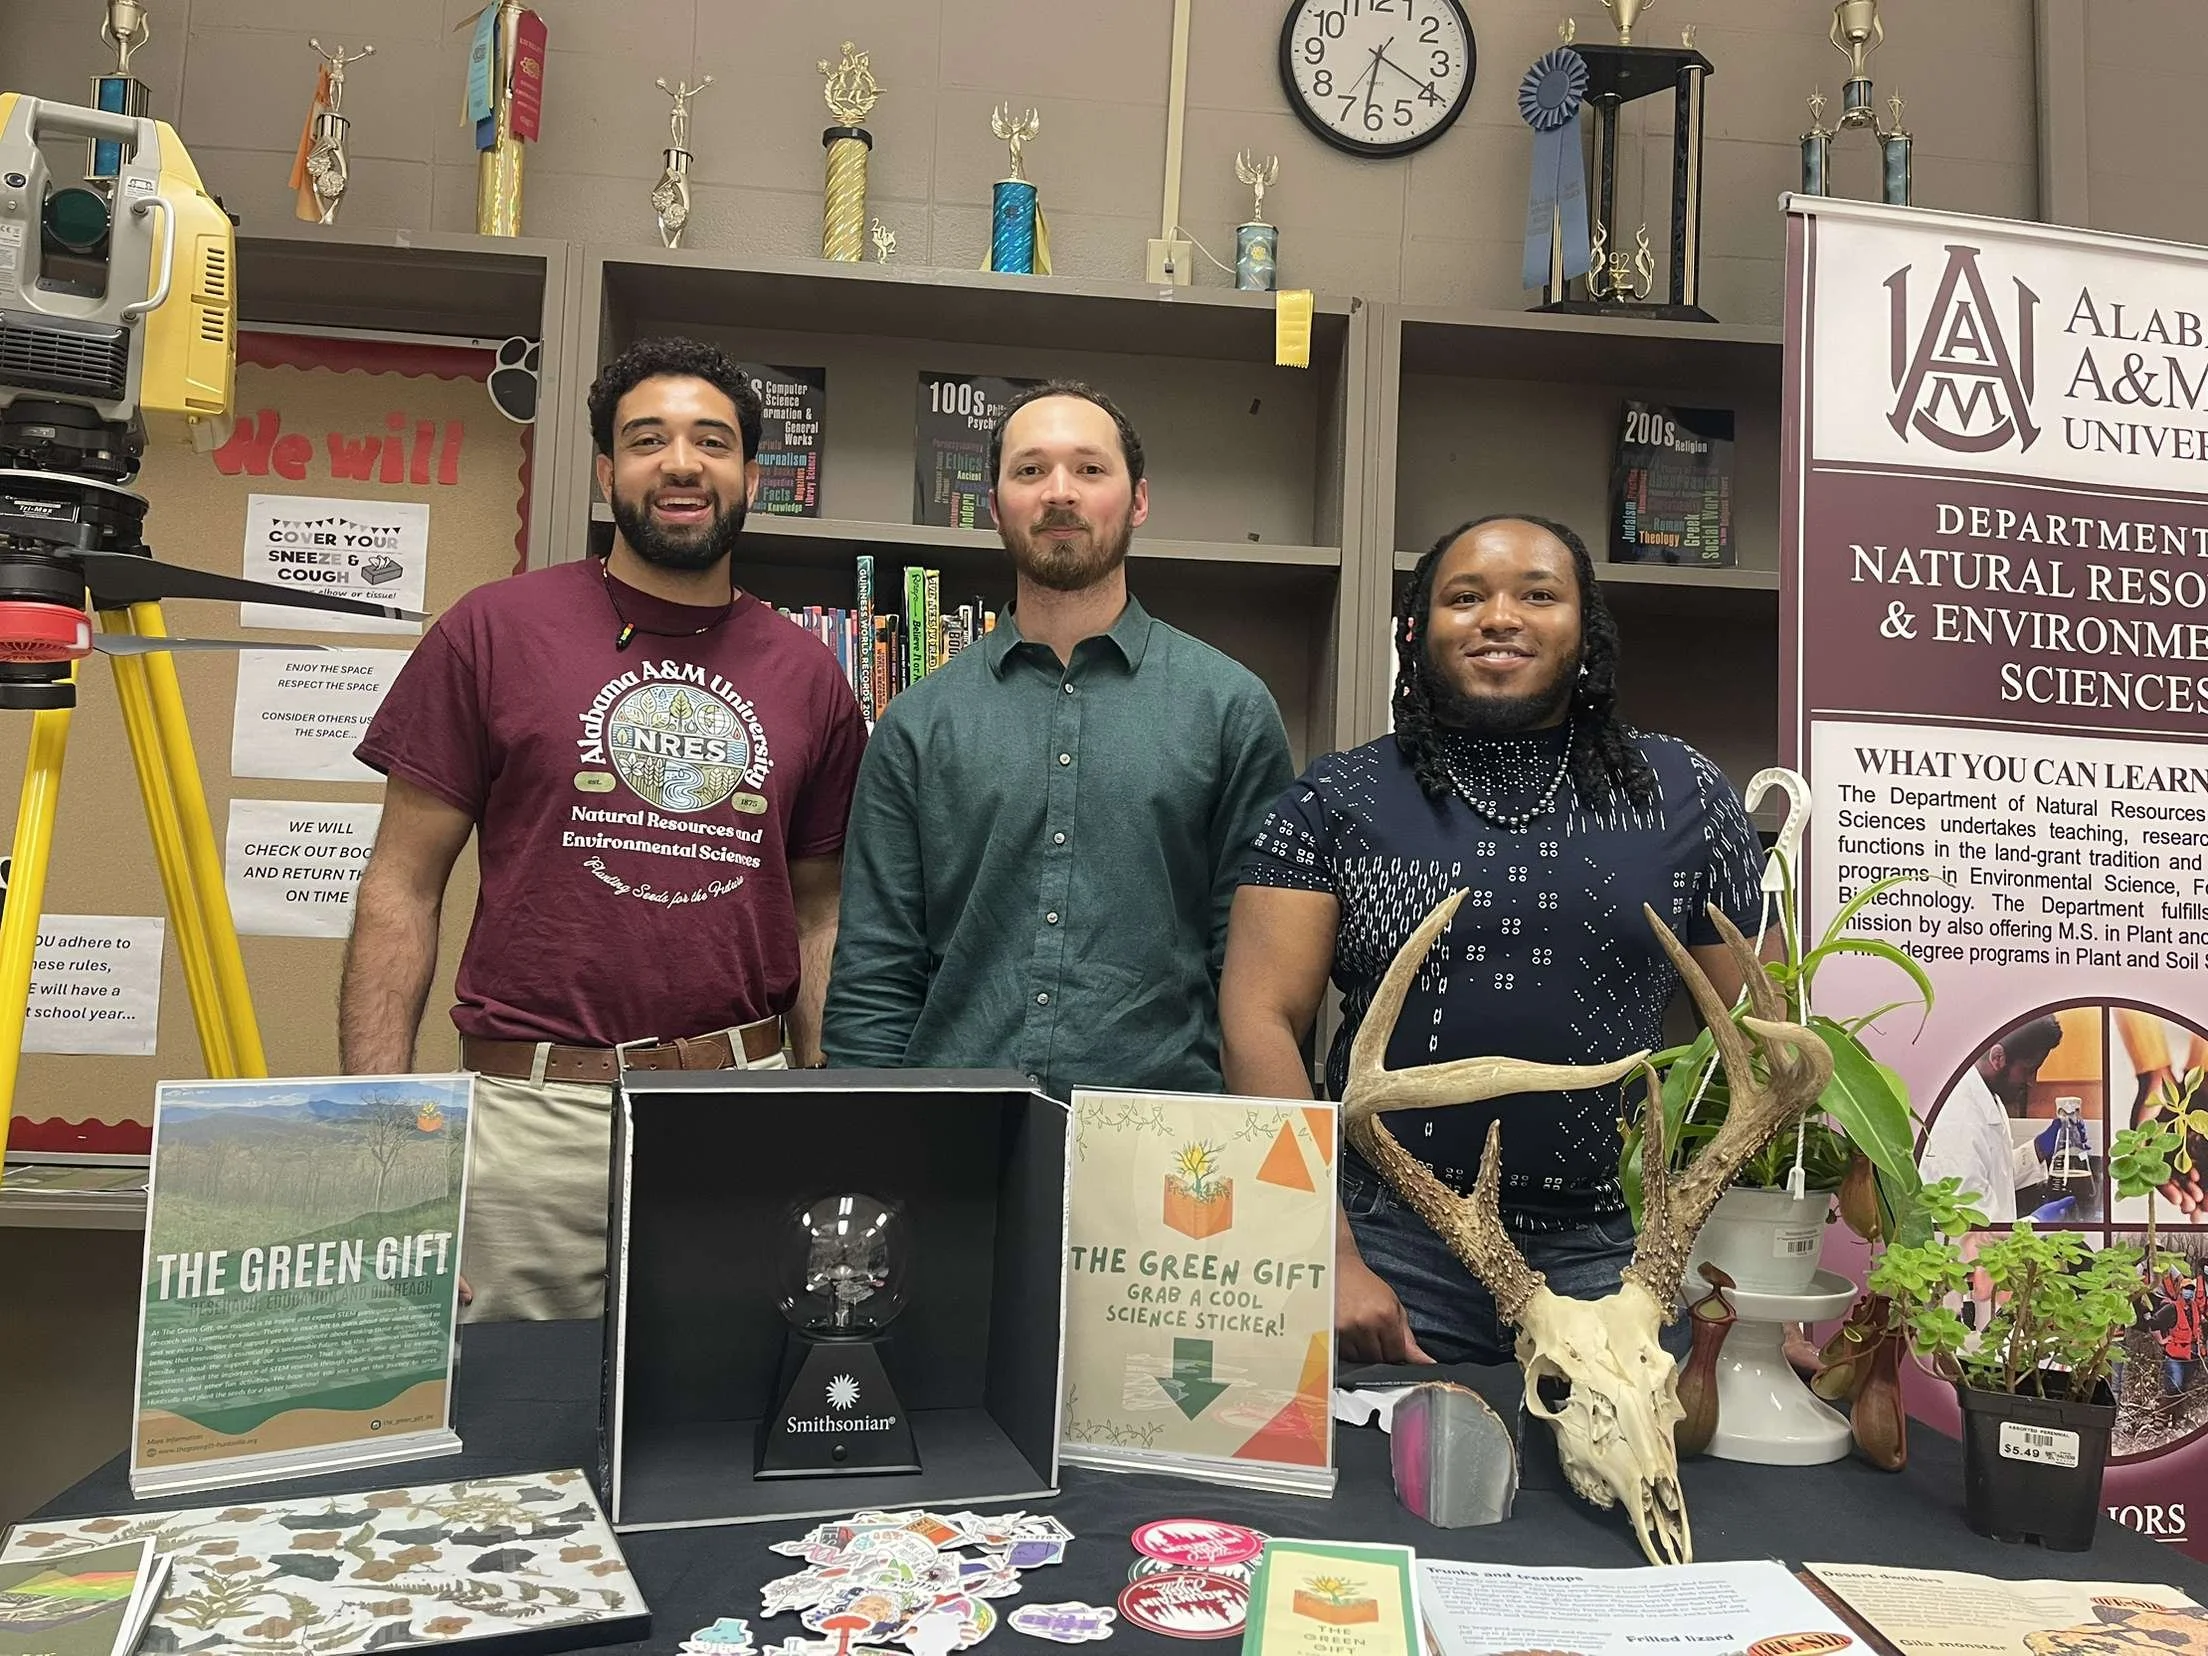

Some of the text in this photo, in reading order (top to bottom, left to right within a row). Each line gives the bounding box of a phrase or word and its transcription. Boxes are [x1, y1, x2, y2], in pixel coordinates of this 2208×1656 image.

[1313, 10, 1345, 39] 10
[1419, 16, 1439, 44] 2
[1305, 37, 1325, 65] 9
[1430, 50, 1450, 77] 3
[1313, 70, 1333, 97] 8
[1418, 81, 1437, 107] 4
[1338, 95, 1357, 121] 7
[1363, 104, 1383, 131] 6
[1393, 100, 1413, 126] 5
[1609, 252, 1631, 272] 92
[765, 381, 808, 396] Computer
[765, 395, 800, 408] Science
[805, 409, 813, 420] &
[785, 421, 819, 435] General
[212, 408, 464, 486] We will
[785, 433, 813, 446] Works
[1675, 440, 1708, 454] Religion
[945, 452, 983, 471] Ethics
[957, 471, 982, 481] Ancient
[1622, 501, 1637, 543] Judaism
[1684, 514, 1701, 547] Greek
[1702, 490, 1720, 559] Social Work
[1936, 503, 2208, 558] DEPARTMENT
[269, 530, 399, 549] COVER YOUR
[1639, 530, 1680, 548] Theology
[268, 550, 359, 566] SNEEZE &
[277, 568, 349, 584] COUGH
[1850, 545, 2076, 599] NATURAL
[351, 590, 397, 600] or tissue!
[859, 568, 871, 702] GUINNESS WORLD RECORDS
[914, 620, 922, 652] Believe
[1879, 600, 2208, 661] & ENVIRONME
[285, 663, 374, 676] ENJOY THE SPACE
[278, 679, 379, 692] RESPECT THE SPACE
[261, 712, 357, 725] CONSIDER OTHERS
[577, 670, 641, 765] Alabama
[641, 659, 706, 686] A&M
[709, 674, 774, 790] University
[295, 728, 357, 740] THE SPACE...
[633, 730, 727, 762] NRES
[1854, 747, 2208, 794] WHAT YOU CAN LEARN
[741, 798, 758, 808] 1875
[1838, 784, 2206, 823] The Department of Natural Resources
[289, 821, 354, 835] WE WILL
[572, 806, 763, 844] Natural Resources and
[1838, 811, 2129, 847] Sciences undertakes teaching,
[244, 843, 337, 859] CHECK OUT
[562, 831, 761, 868] Environmental Sciences
[1838, 835, 2202, 871] functions in the land-grant tradition and
[243, 866, 345, 881] AND RETURN
[583, 855, 745, 908] Planting Seeds for the Future
[1942, 865, 2181, 897] in Environmental Science,
[286, 889, 350, 904] ON TIME
[1992, 893, 2144, 919] The Department
[1920, 915, 2172, 945] by also offering M.S. in Plant
[58, 935, 131, 949] adhere to
[69, 959, 112, 973] rules,
[1969, 945, 2199, 970] programs in Plant and Soil
[40, 982, 121, 997] will have a
[34, 1006, 136, 1022] school year...
[157, 1232, 452, 1300] THE GREEN GIFT
[1071, 1246, 1326, 1290] THE GREEN GIFT
[1127, 1283, 1263, 1309] GRAB A COOL
[1106, 1305, 1285, 1337] SCIENCE STICKER!
[2004, 1444, 2039, 1458] $5.49
[1426, 1567, 1584, 1583] Trunks and treetops
[1822, 1570, 1943, 1584] Desert dwellers
[1304, 1633, 1365, 1645] GREEN
[1317, 1625, 1351, 1635] THE
[1626, 1633, 1734, 1644] Frilled lizard
[1314, 1644, 1356, 1654] GIFT
[1900, 1638, 2008, 1652] Gila monster
